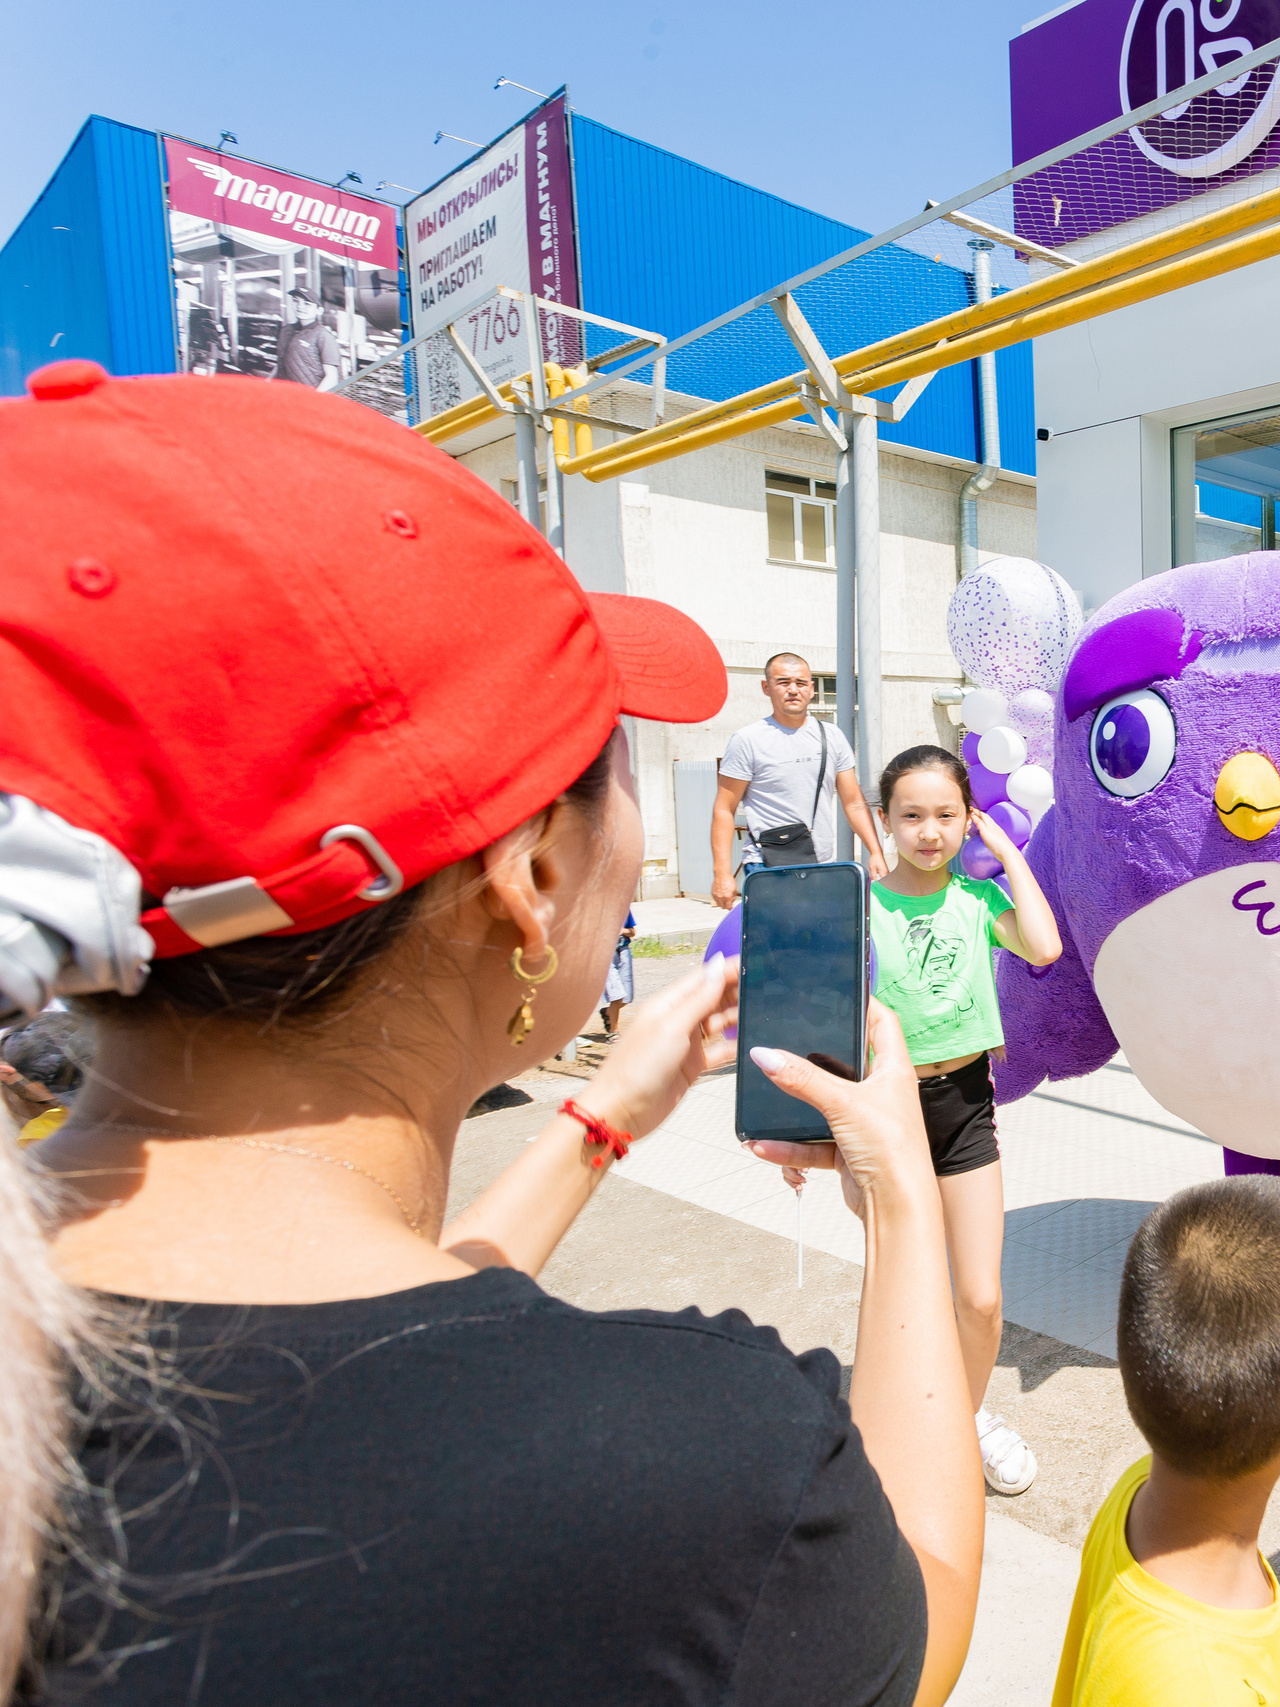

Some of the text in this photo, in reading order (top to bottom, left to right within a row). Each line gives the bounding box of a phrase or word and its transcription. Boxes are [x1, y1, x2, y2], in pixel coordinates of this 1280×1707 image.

[205, 165, 381, 240] magnum
[417, 153, 519, 243] МЫ ОТКРЫЛИСЬ!
[292, 221, 375, 252] EXPRESS
[419, 215, 497, 285] ПРИГЛАШАЕМ
[536, 121, 559, 363] МОУ В МАГНУМ
[420, 254, 483, 312] НА РАБОТУ!
